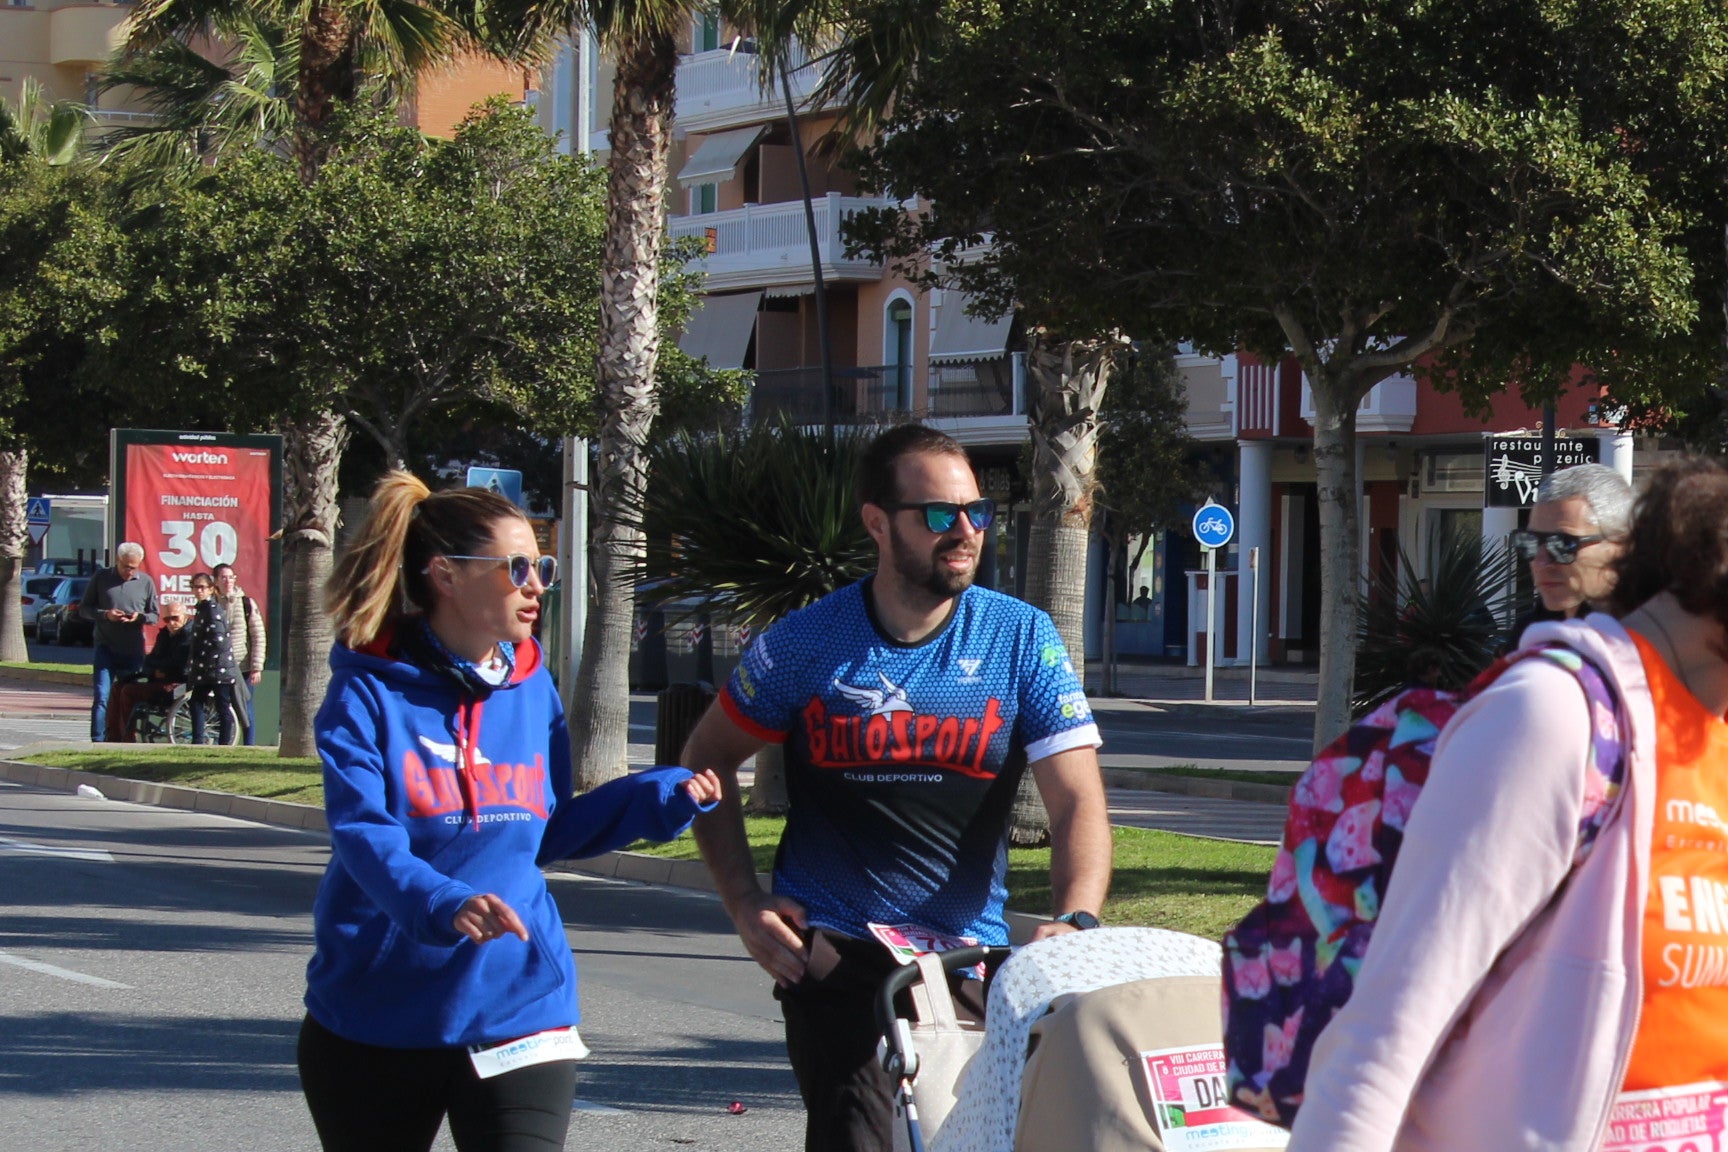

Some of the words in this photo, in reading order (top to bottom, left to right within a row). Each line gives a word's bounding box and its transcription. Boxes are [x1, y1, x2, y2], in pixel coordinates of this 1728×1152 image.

[1493, 439, 1583, 451] restaunte
[172, 451, 228, 464] worten
[160, 495, 238, 507] FINANCIACIÓN
[183, 512, 215, 520] HASTA
[159, 521, 238, 569] 30
[843, 772, 875, 782] CLUB
[877, 773, 944, 783] DEPORTIVO
[476, 812, 533, 823] DEPORTIVO
[1170, 1055, 1185, 1065] VIII
[1185, 1050, 1225, 1063] CARRERA
[1173, 1063, 1206, 1076] CIUDAD
[1206, 1062, 1219, 1072] DE
[1193, 1076, 1229, 1108] DA
[1662, 1093, 1711, 1117] POPULAR
[1629, 1123, 1648, 1141] DE
[1650, 1114, 1708, 1137] ROQUETAS
